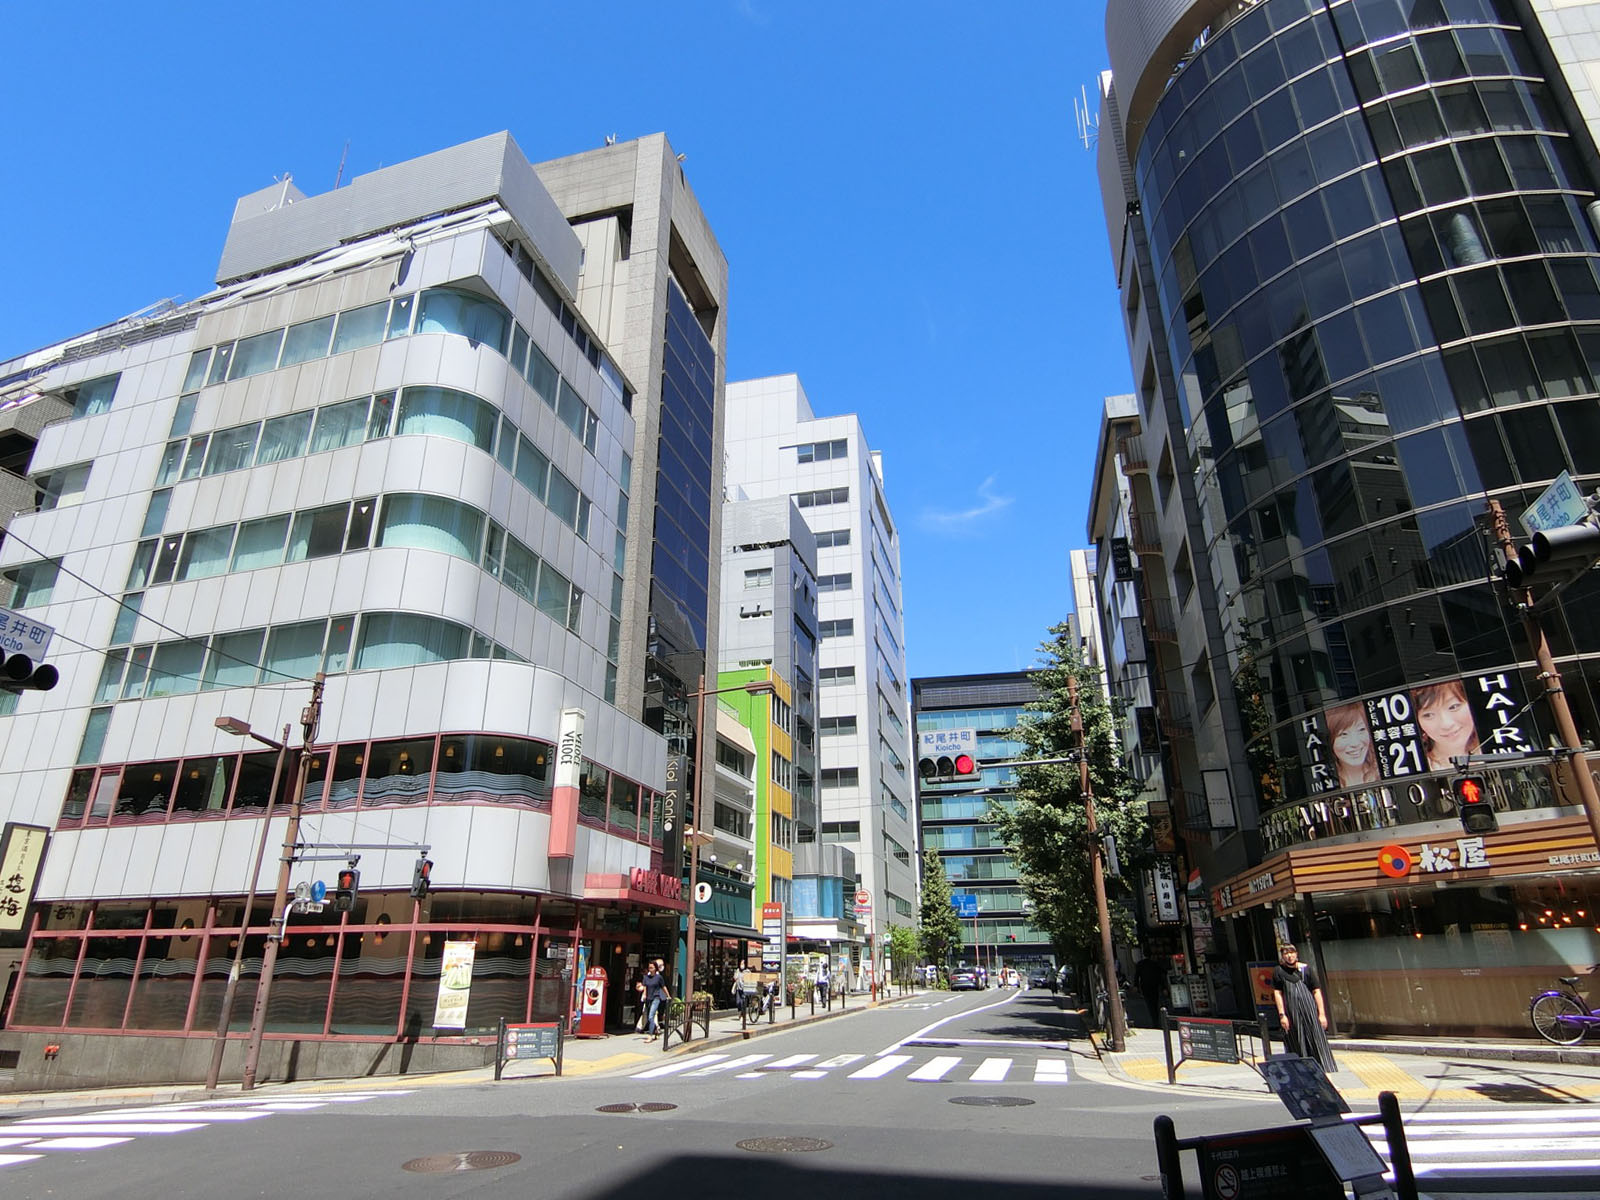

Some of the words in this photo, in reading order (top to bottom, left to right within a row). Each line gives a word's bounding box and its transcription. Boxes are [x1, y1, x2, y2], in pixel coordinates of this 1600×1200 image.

[1367, 700, 1379, 726] OPEN
[1377, 693, 1410, 724] 10
[1478, 674, 1523, 744] HAIR
[560, 730, 575, 766] VELOCE
[924, 731, 971, 744] 紀尾井町
[935, 743, 961, 752] Kioicho
[1301, 716, 1328, 779] HAIR
[1373, 723, 1416, 742] 美容室
[666, 759, 678, 782] Kioi
[1378, 745, 1391, 777] CLOSE
[1389, 740, 1422, 775] 21
[1311, 781, 1324, 793] IN
[1297, 783, 1426, 825] ANGELO
[1419, 837, 1490, 873] 松屋
